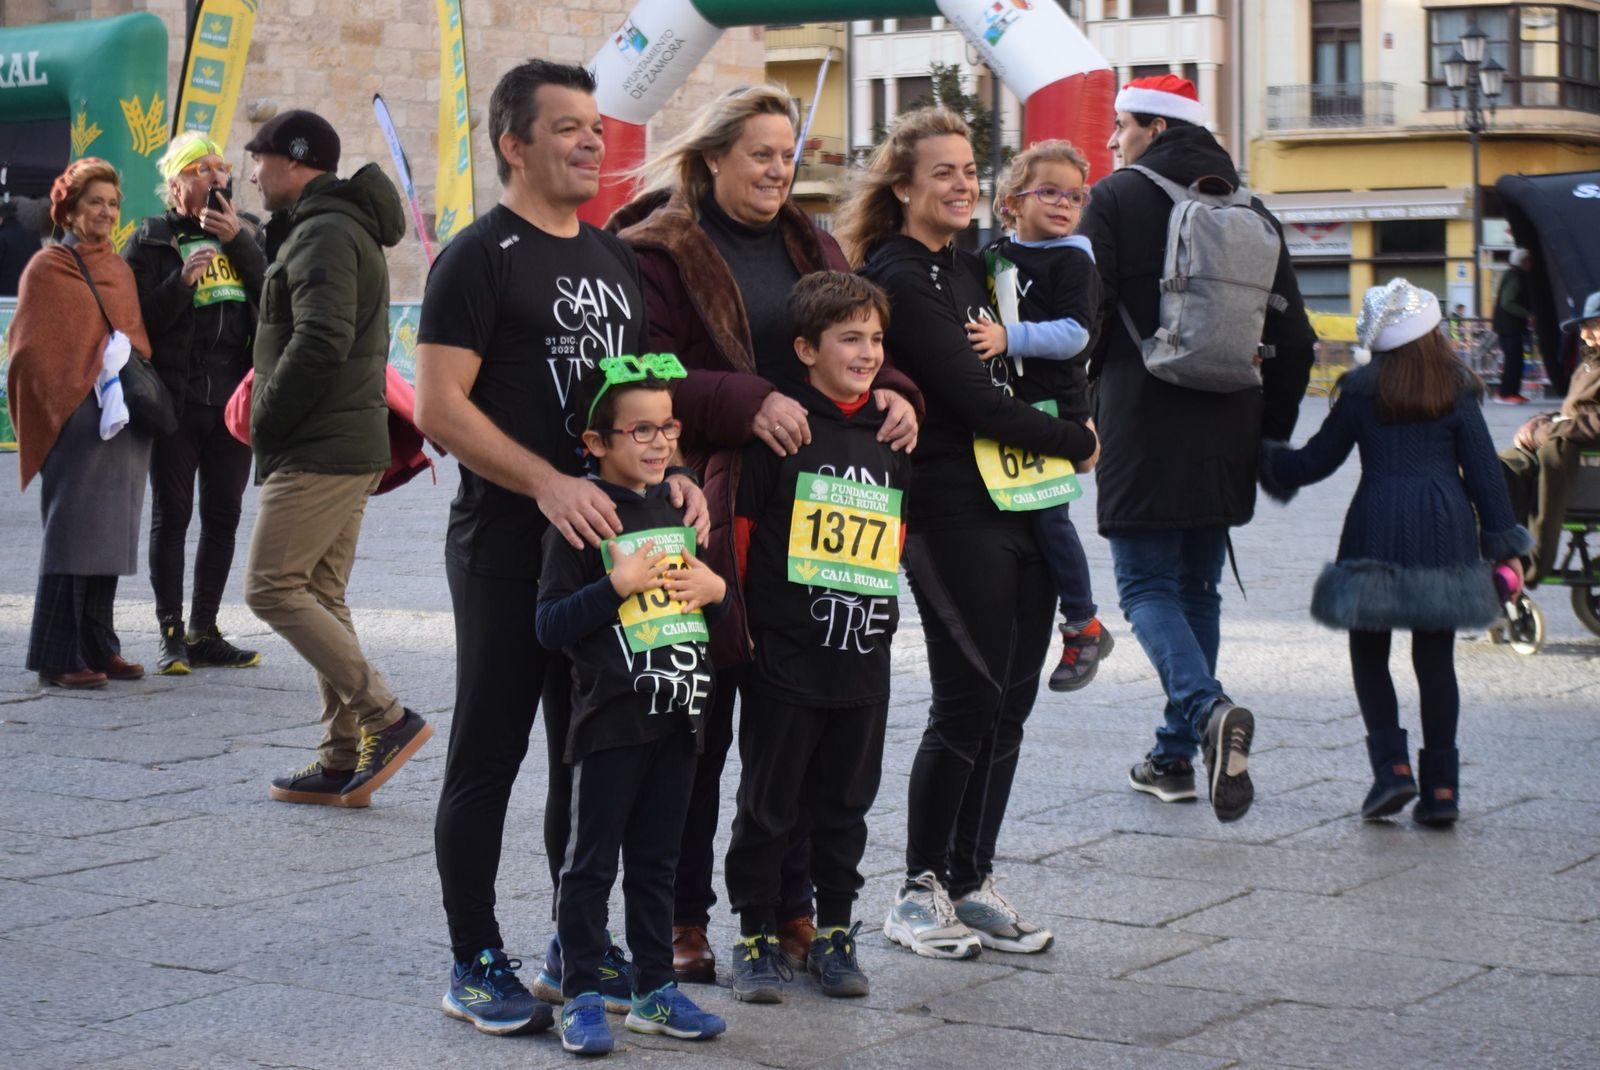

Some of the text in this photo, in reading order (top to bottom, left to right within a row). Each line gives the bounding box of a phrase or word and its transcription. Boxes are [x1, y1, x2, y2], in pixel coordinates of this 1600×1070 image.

[622, 29, 674, 92] AYUNTAMIENTO
[630, 38, 687, 100] DE ZAMORA
[1573, 184, 1600, 198] S
[553, 277, 631, 331] SAN
[545, 335, 579, 346] 31 DIC.
[551, 346, 575, 355] 2022
[831, 493, 855, 507] CAJA
[855, 499, 889, 513] RURAL
[1013, 482, 1075, 504] CAJA RURAL
[806, 508, 887, 561] 1377
[821, 568, 893, 589] CAJA RURAL
[662, 621, 687, 636] CAJA
[810, 598, 890, 654] TRE
